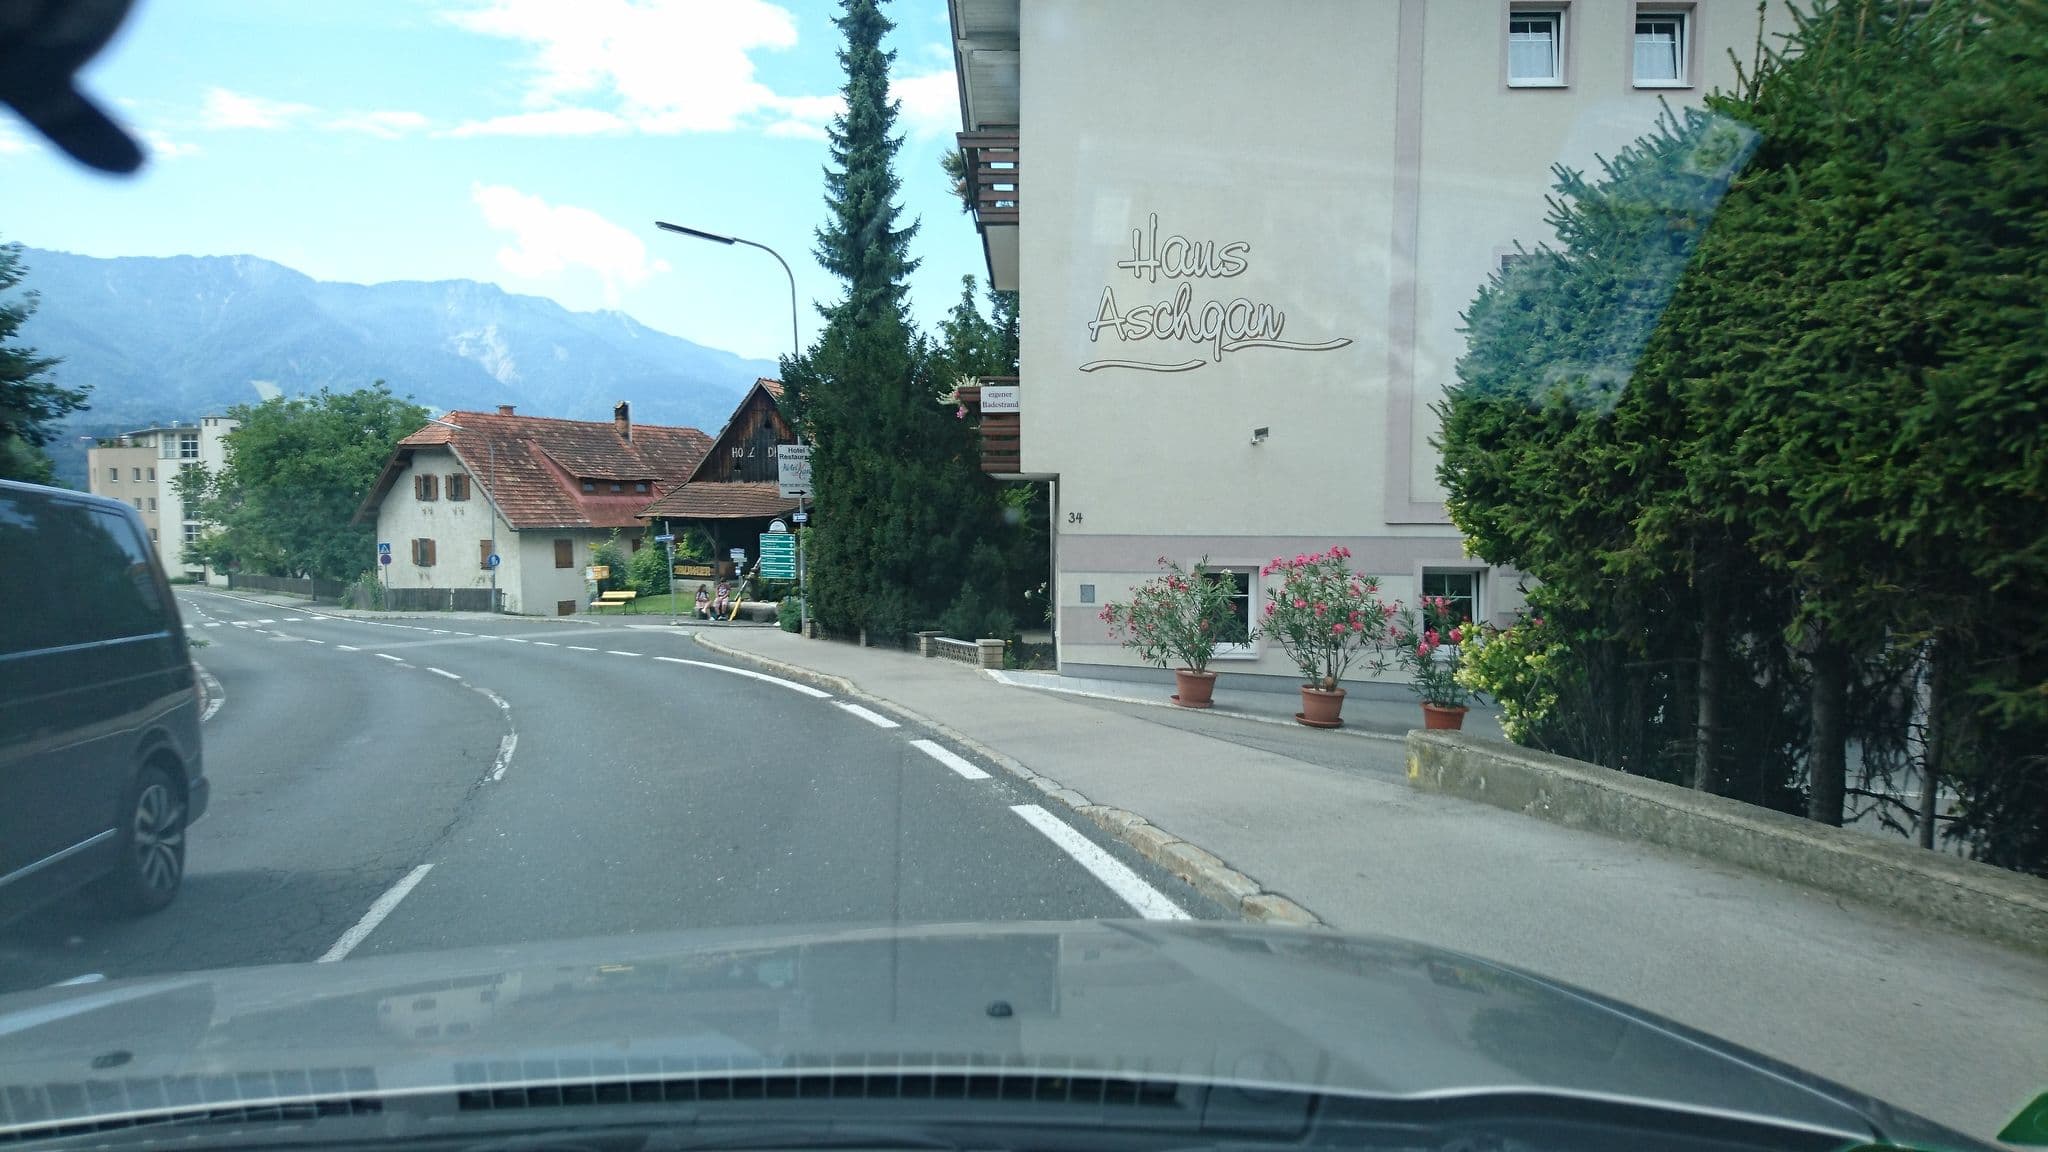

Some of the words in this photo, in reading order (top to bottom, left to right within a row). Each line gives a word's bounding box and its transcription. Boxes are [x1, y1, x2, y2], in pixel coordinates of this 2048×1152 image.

[1117, 212, 1251, 283] Haus
[988, 391, 1013, 399] eigener
[982, 400, 1019, 409] Badestrand
[1068, 512, 1084, 524] 34
